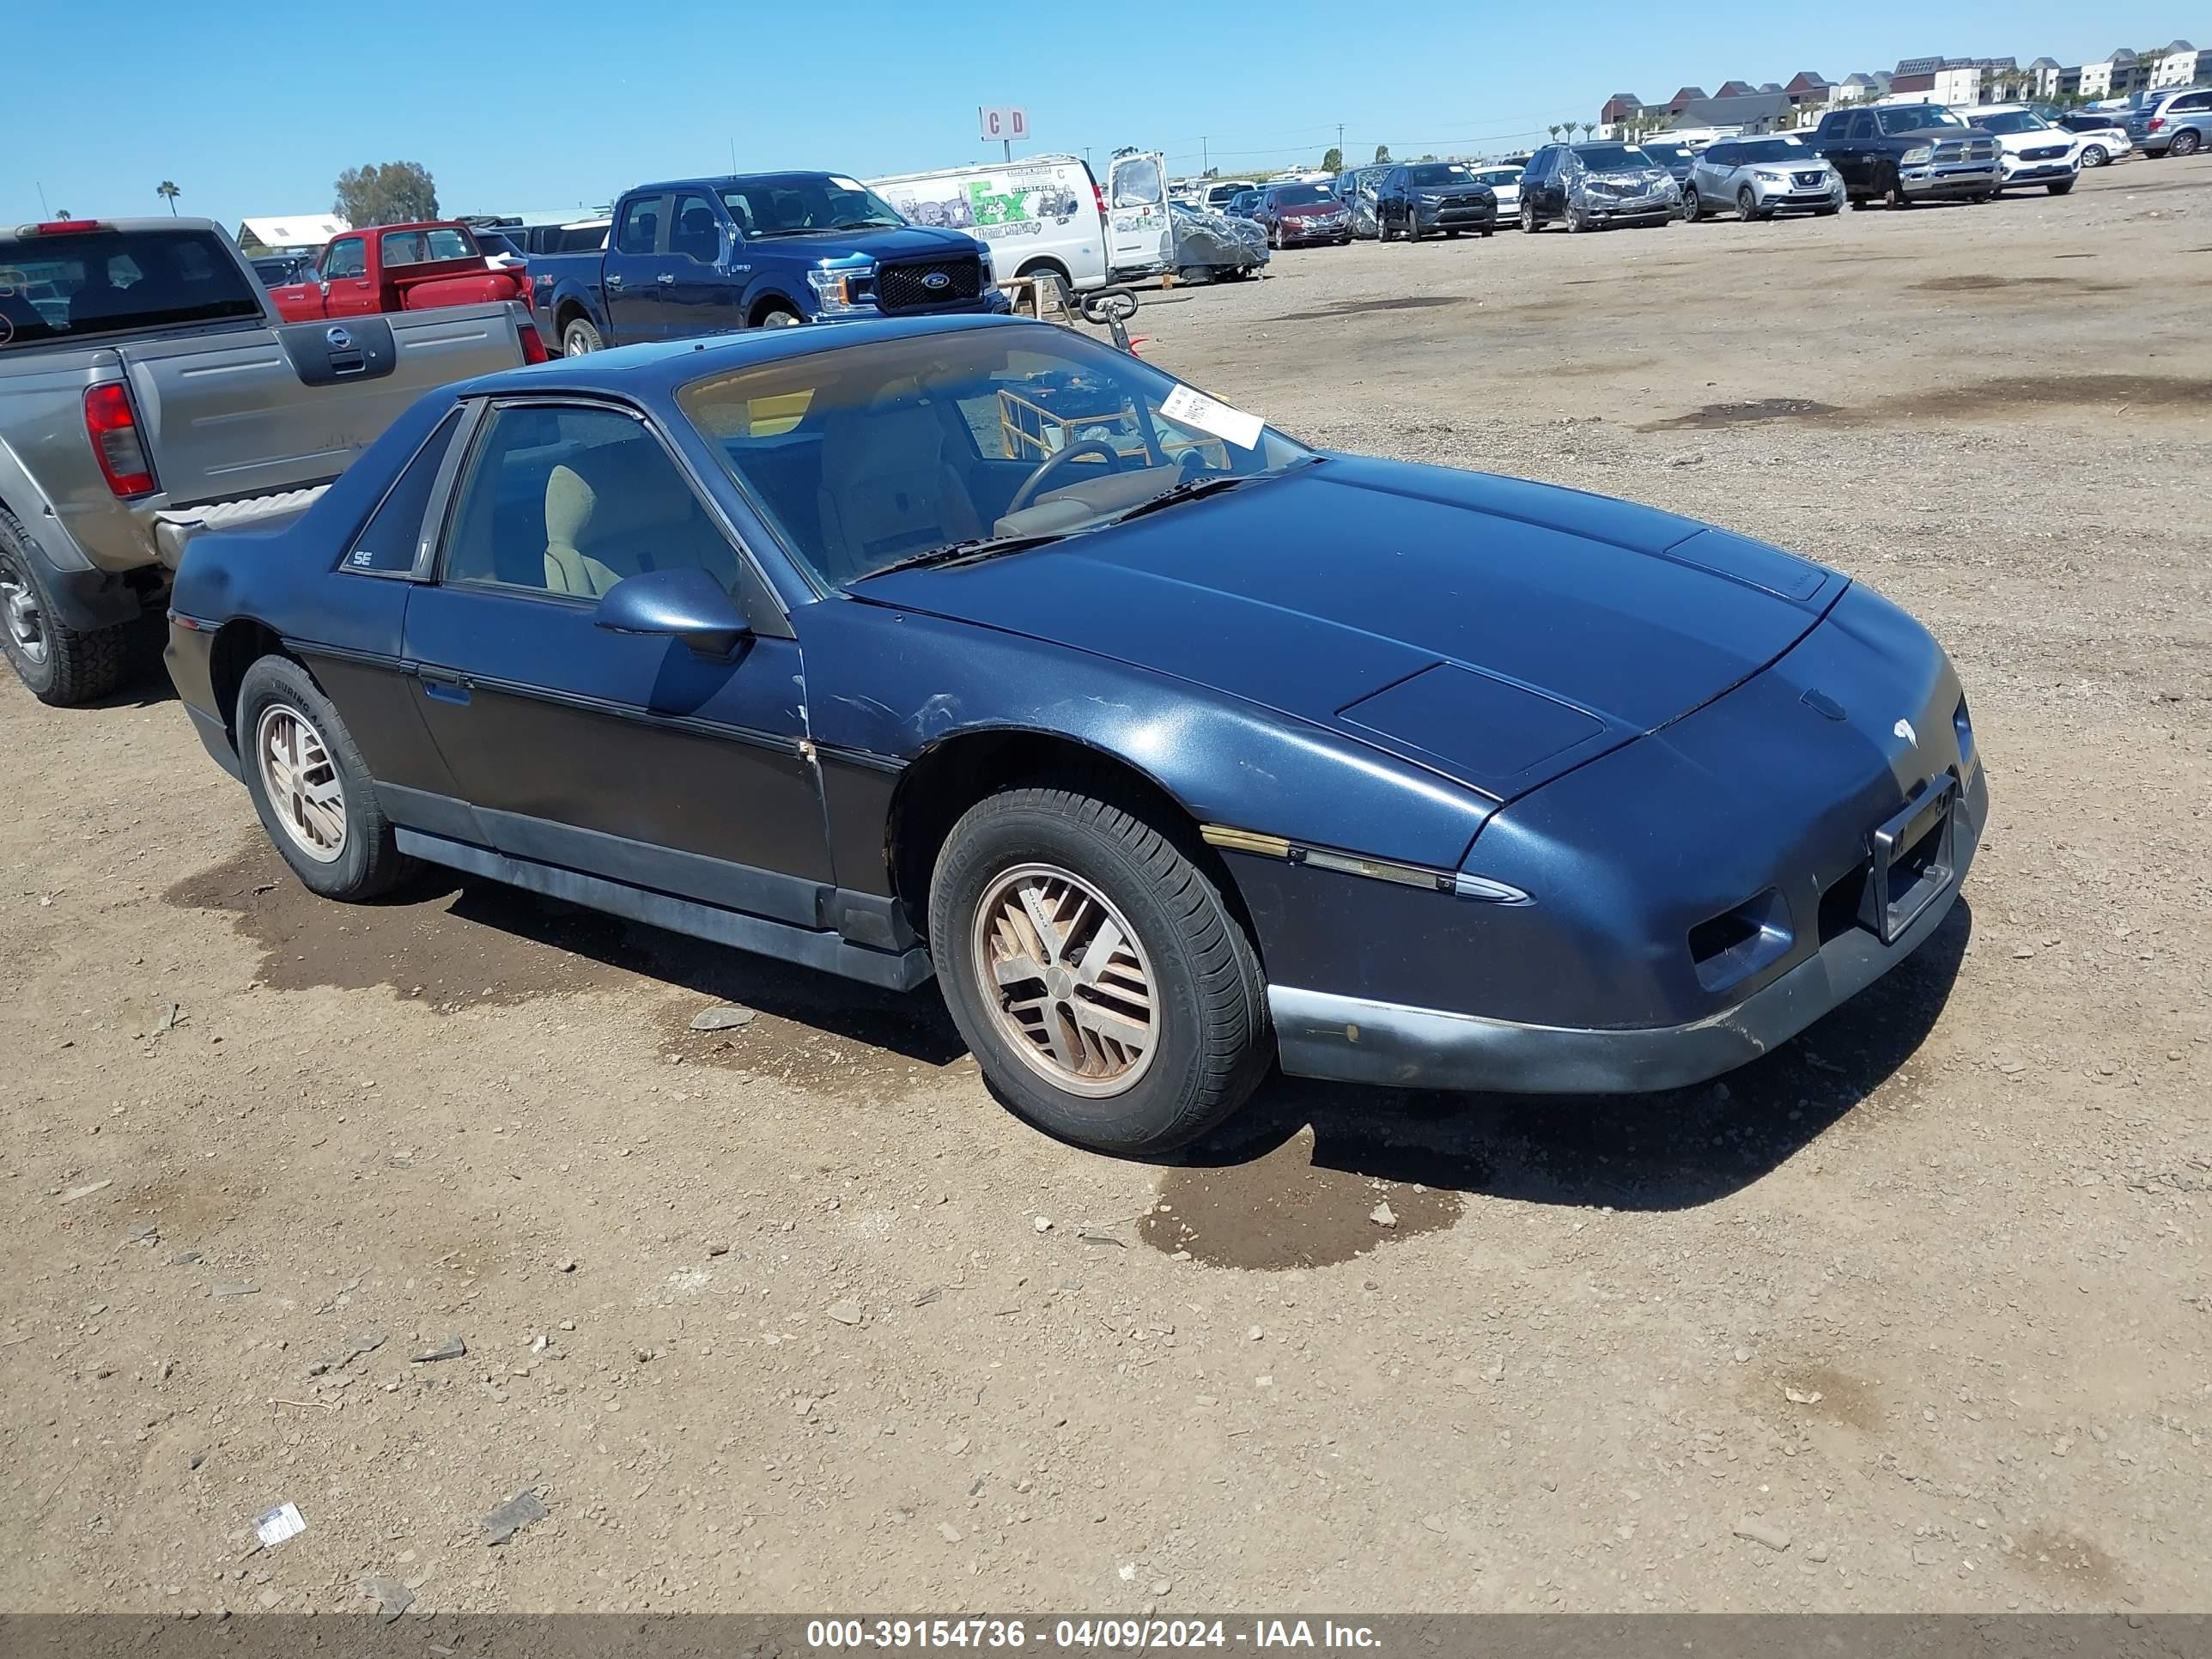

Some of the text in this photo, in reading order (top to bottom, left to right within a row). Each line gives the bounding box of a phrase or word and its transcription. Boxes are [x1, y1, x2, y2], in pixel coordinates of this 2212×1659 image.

[988, 111, 1023, 135] C D
[354, 551, 373, 566] SE
